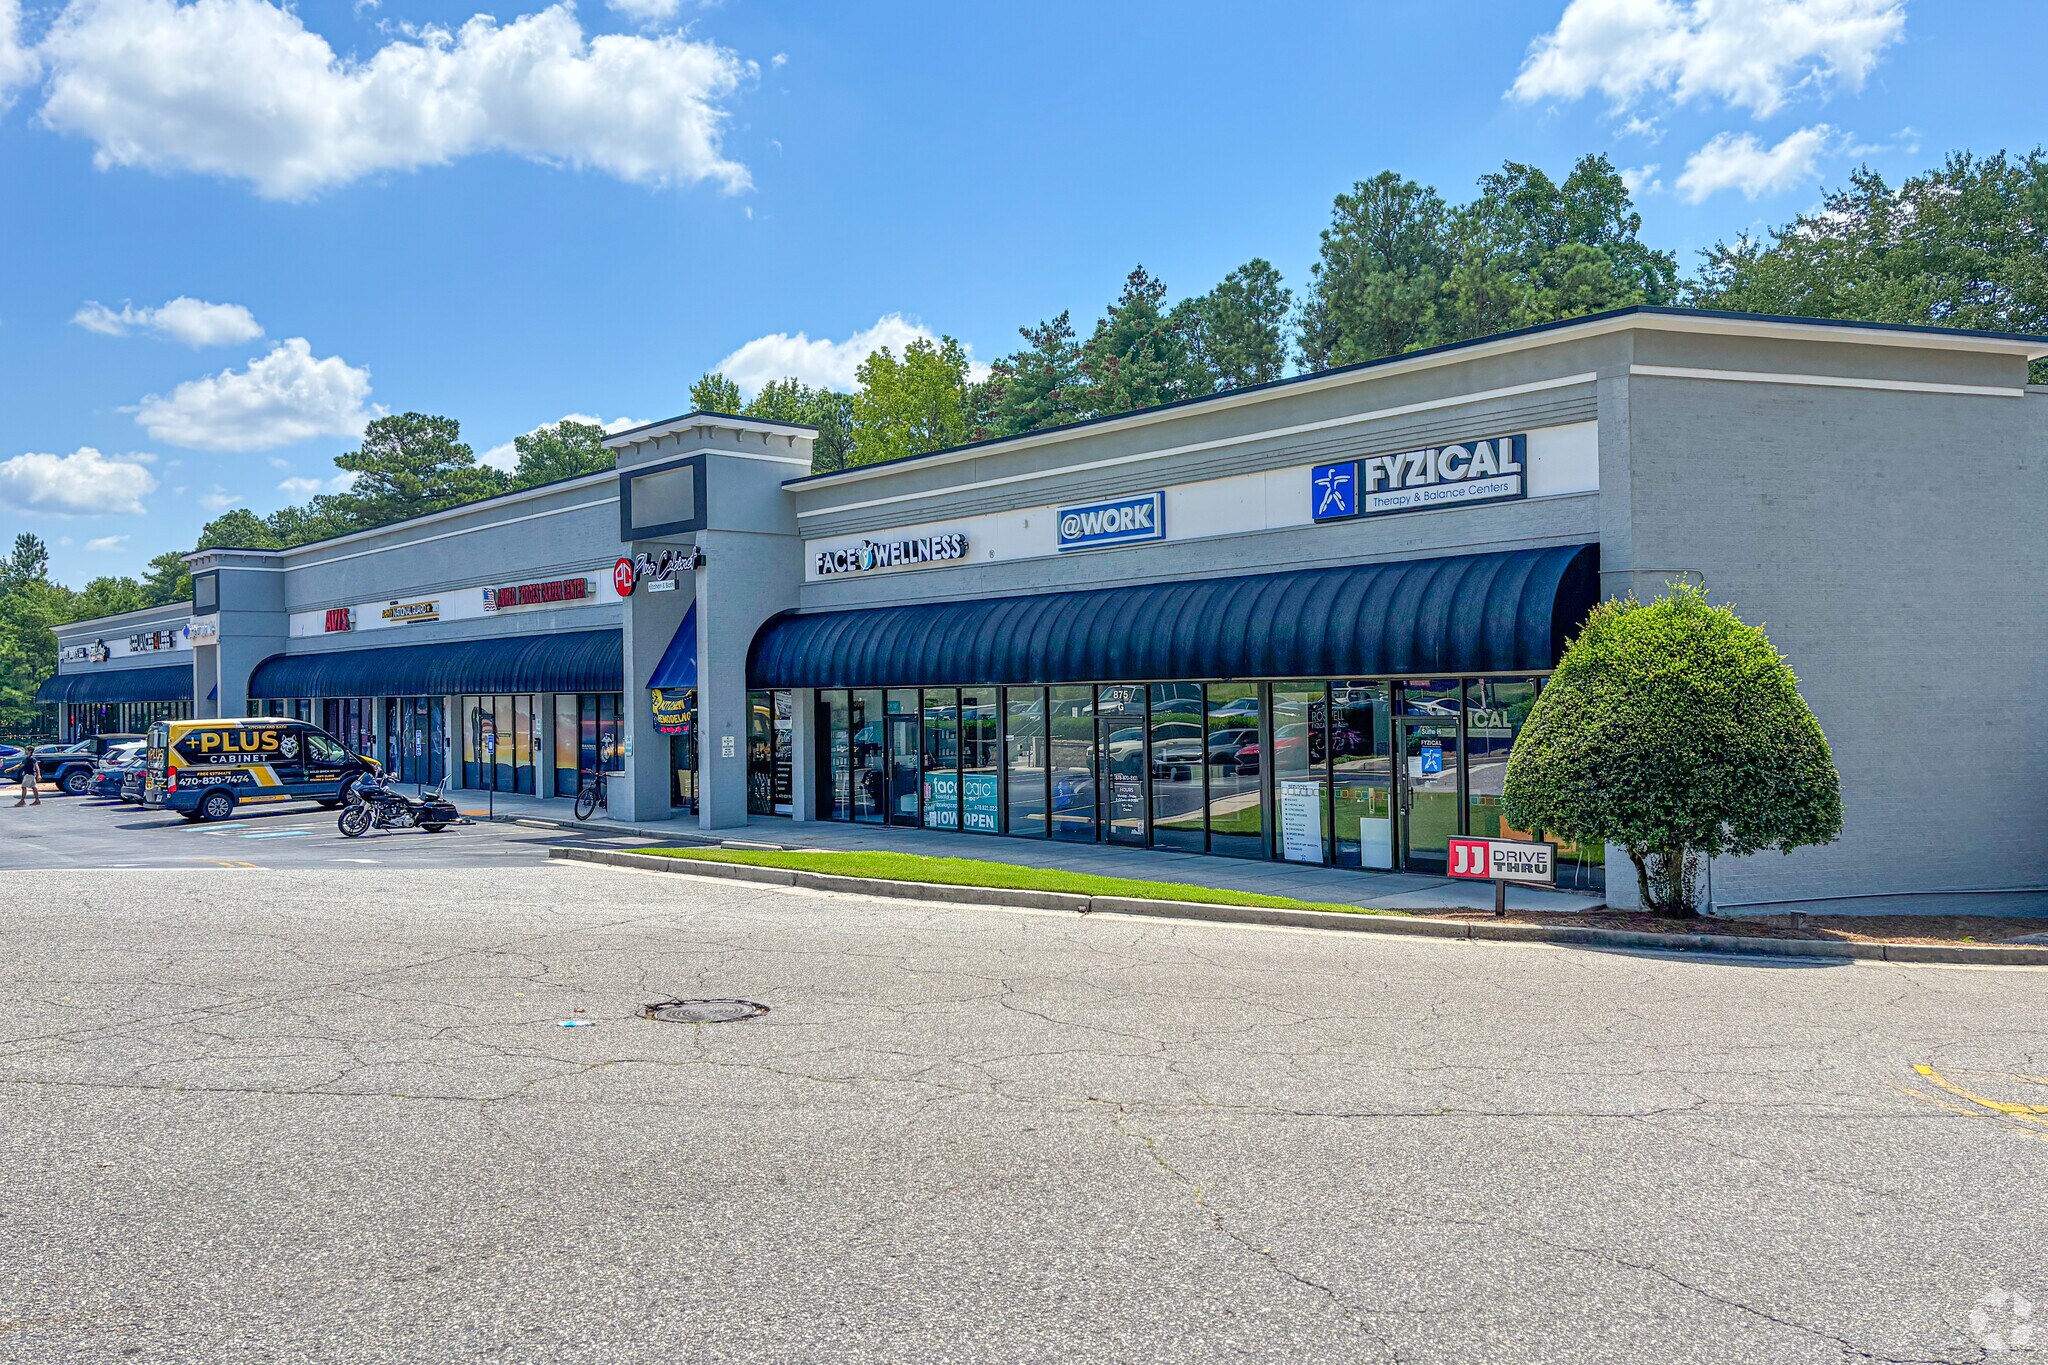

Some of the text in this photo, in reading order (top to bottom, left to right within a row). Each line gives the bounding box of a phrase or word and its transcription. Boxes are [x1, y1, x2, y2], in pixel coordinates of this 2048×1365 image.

[1366, 438, 1521, 492] FYZICAL
[1374, 481, 1509, 507] Therapy & Balance Centers
[1061, 504, 1154, 539] @WORK
[634, 546, 698, 582] Plus Cabinet
[815, 534, 963, 575] FACE WELLNESS
[498, 578, 586, 608] ARMED FORCES CAREER CENTER
[325, 608, 350, 632] AVIS
[393, 605, 412, 617] NATIONAL
[411, 603, 427, 614] GUARD
[1113, 690, 1129, 699] 875
[1311, 711, 1345, 721] ROSELL
[210, 754, 268, 764] CABINET
[178, 775, 250, 786] 470-820-7474
[964, 812, 995, 828] OPEN
[1454, 845, 1485, 875] JJ
[1493, 850, 1548, 864] DRIVE
[1493, 861, 1548, 875] THRU
